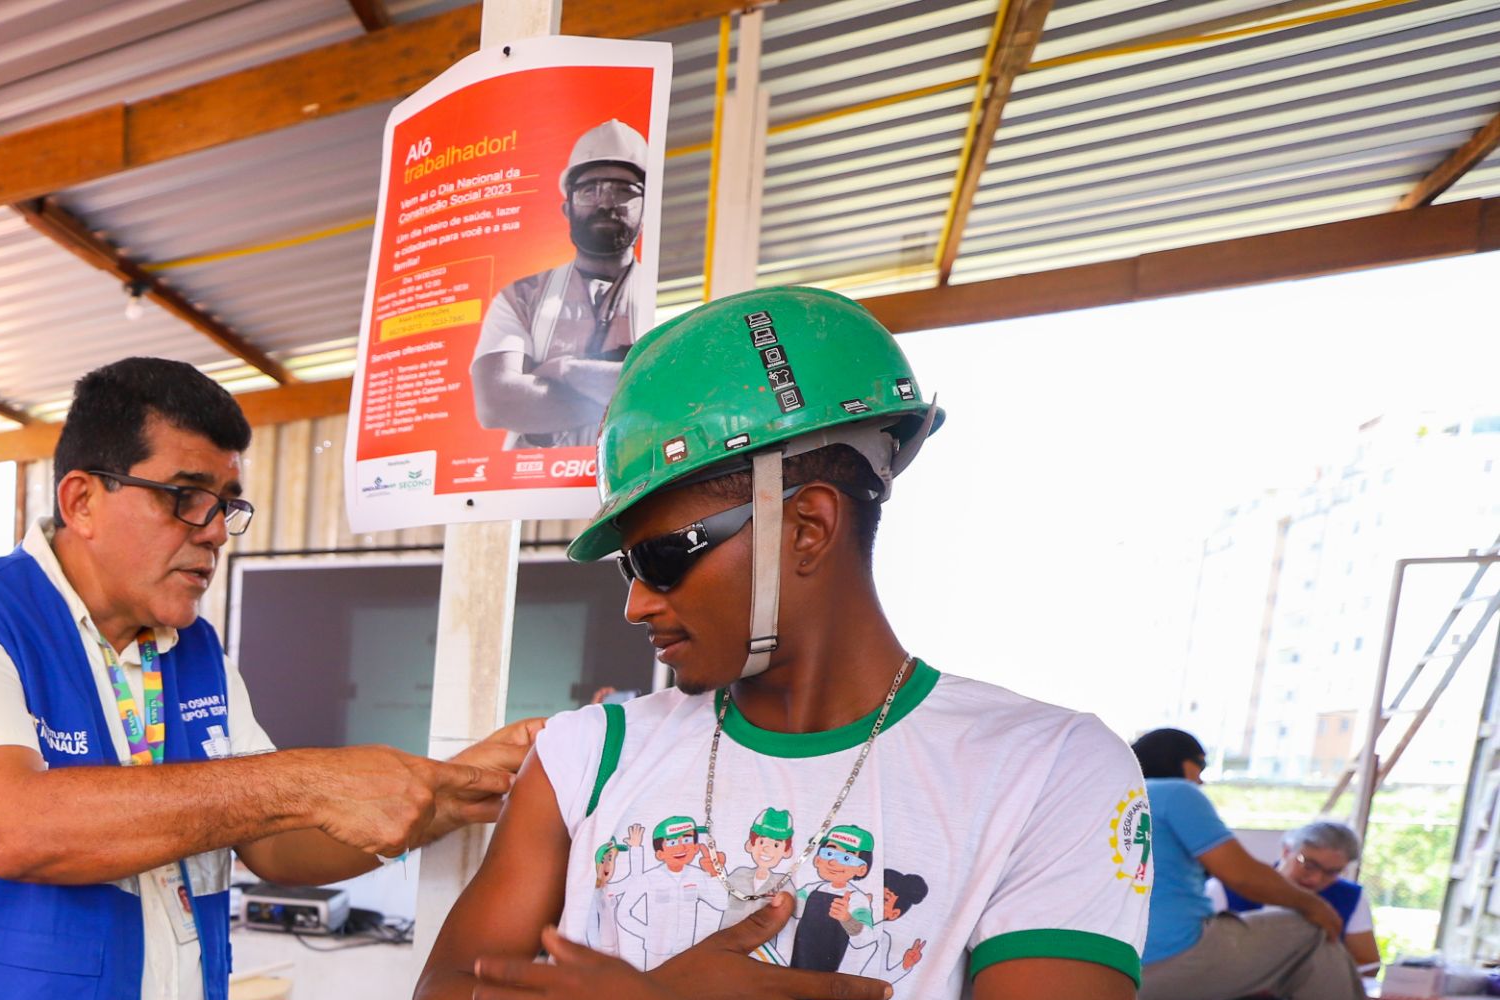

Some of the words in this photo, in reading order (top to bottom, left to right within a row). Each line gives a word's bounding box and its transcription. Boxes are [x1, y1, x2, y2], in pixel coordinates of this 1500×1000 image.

[404, 130, 517, 184] trabalhador!
[405, 136, 432, 166] Alô
[438, 182, 455, 197] Dia
[457, 168, 503, 189] Nacional
[506, 167, 521, 179] da
[449, 188, 482, 206] Social
[483, 182, 513, 199] 2023
[496, 204, 521, 218] lazer
[501, 220, 521, 232] sua
[189, 696, 219, 710] OSMAR
[74, 731, 88, 742] DE
[832, 832, 858, 845] HONDA
